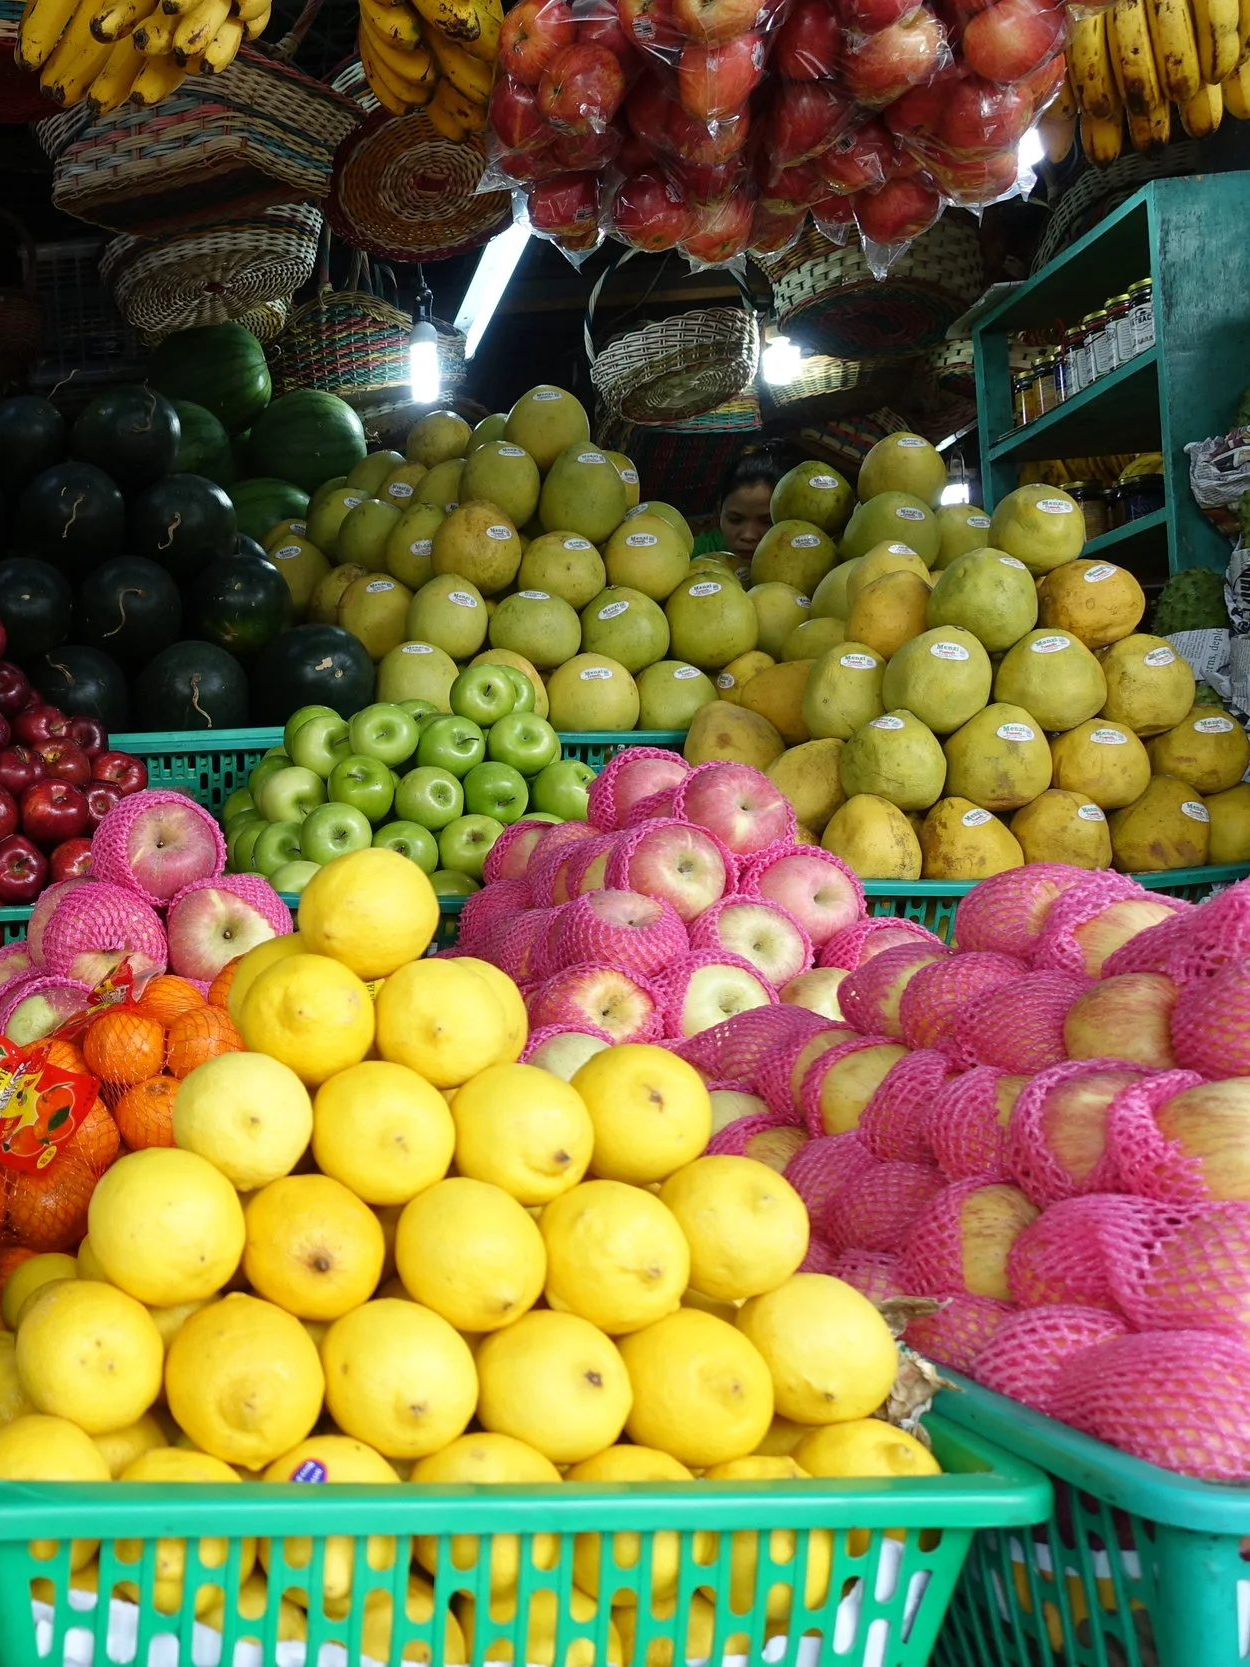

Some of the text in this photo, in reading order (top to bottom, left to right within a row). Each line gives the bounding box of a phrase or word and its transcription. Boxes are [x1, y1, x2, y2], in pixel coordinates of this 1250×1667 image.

[602, 603, 621, 615] Menzi
[1036, 637, 1058, 647] Menzi
[936, 644, 960, 652] Menzi
